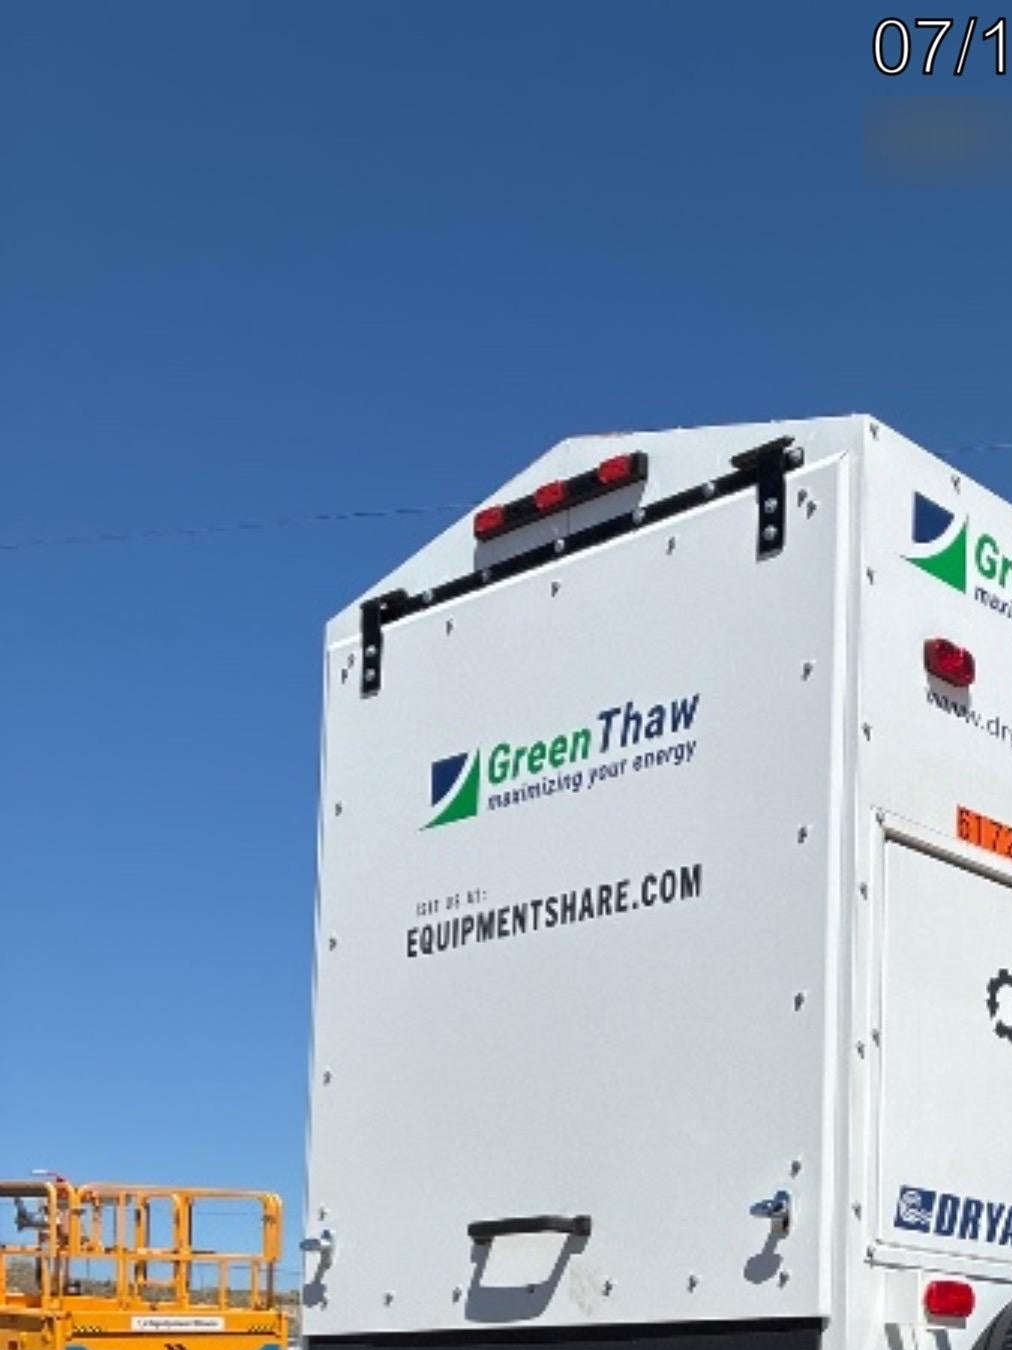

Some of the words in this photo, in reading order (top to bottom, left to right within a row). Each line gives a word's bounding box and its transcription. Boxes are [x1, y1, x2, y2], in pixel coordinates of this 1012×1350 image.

[487, 771, 584, 811] maximizing
[588, 759, 628, 790] your
[633, 740, 698, 771] energy
[407, 863, 701, 957] EQUIPMENTSHARE.COM
